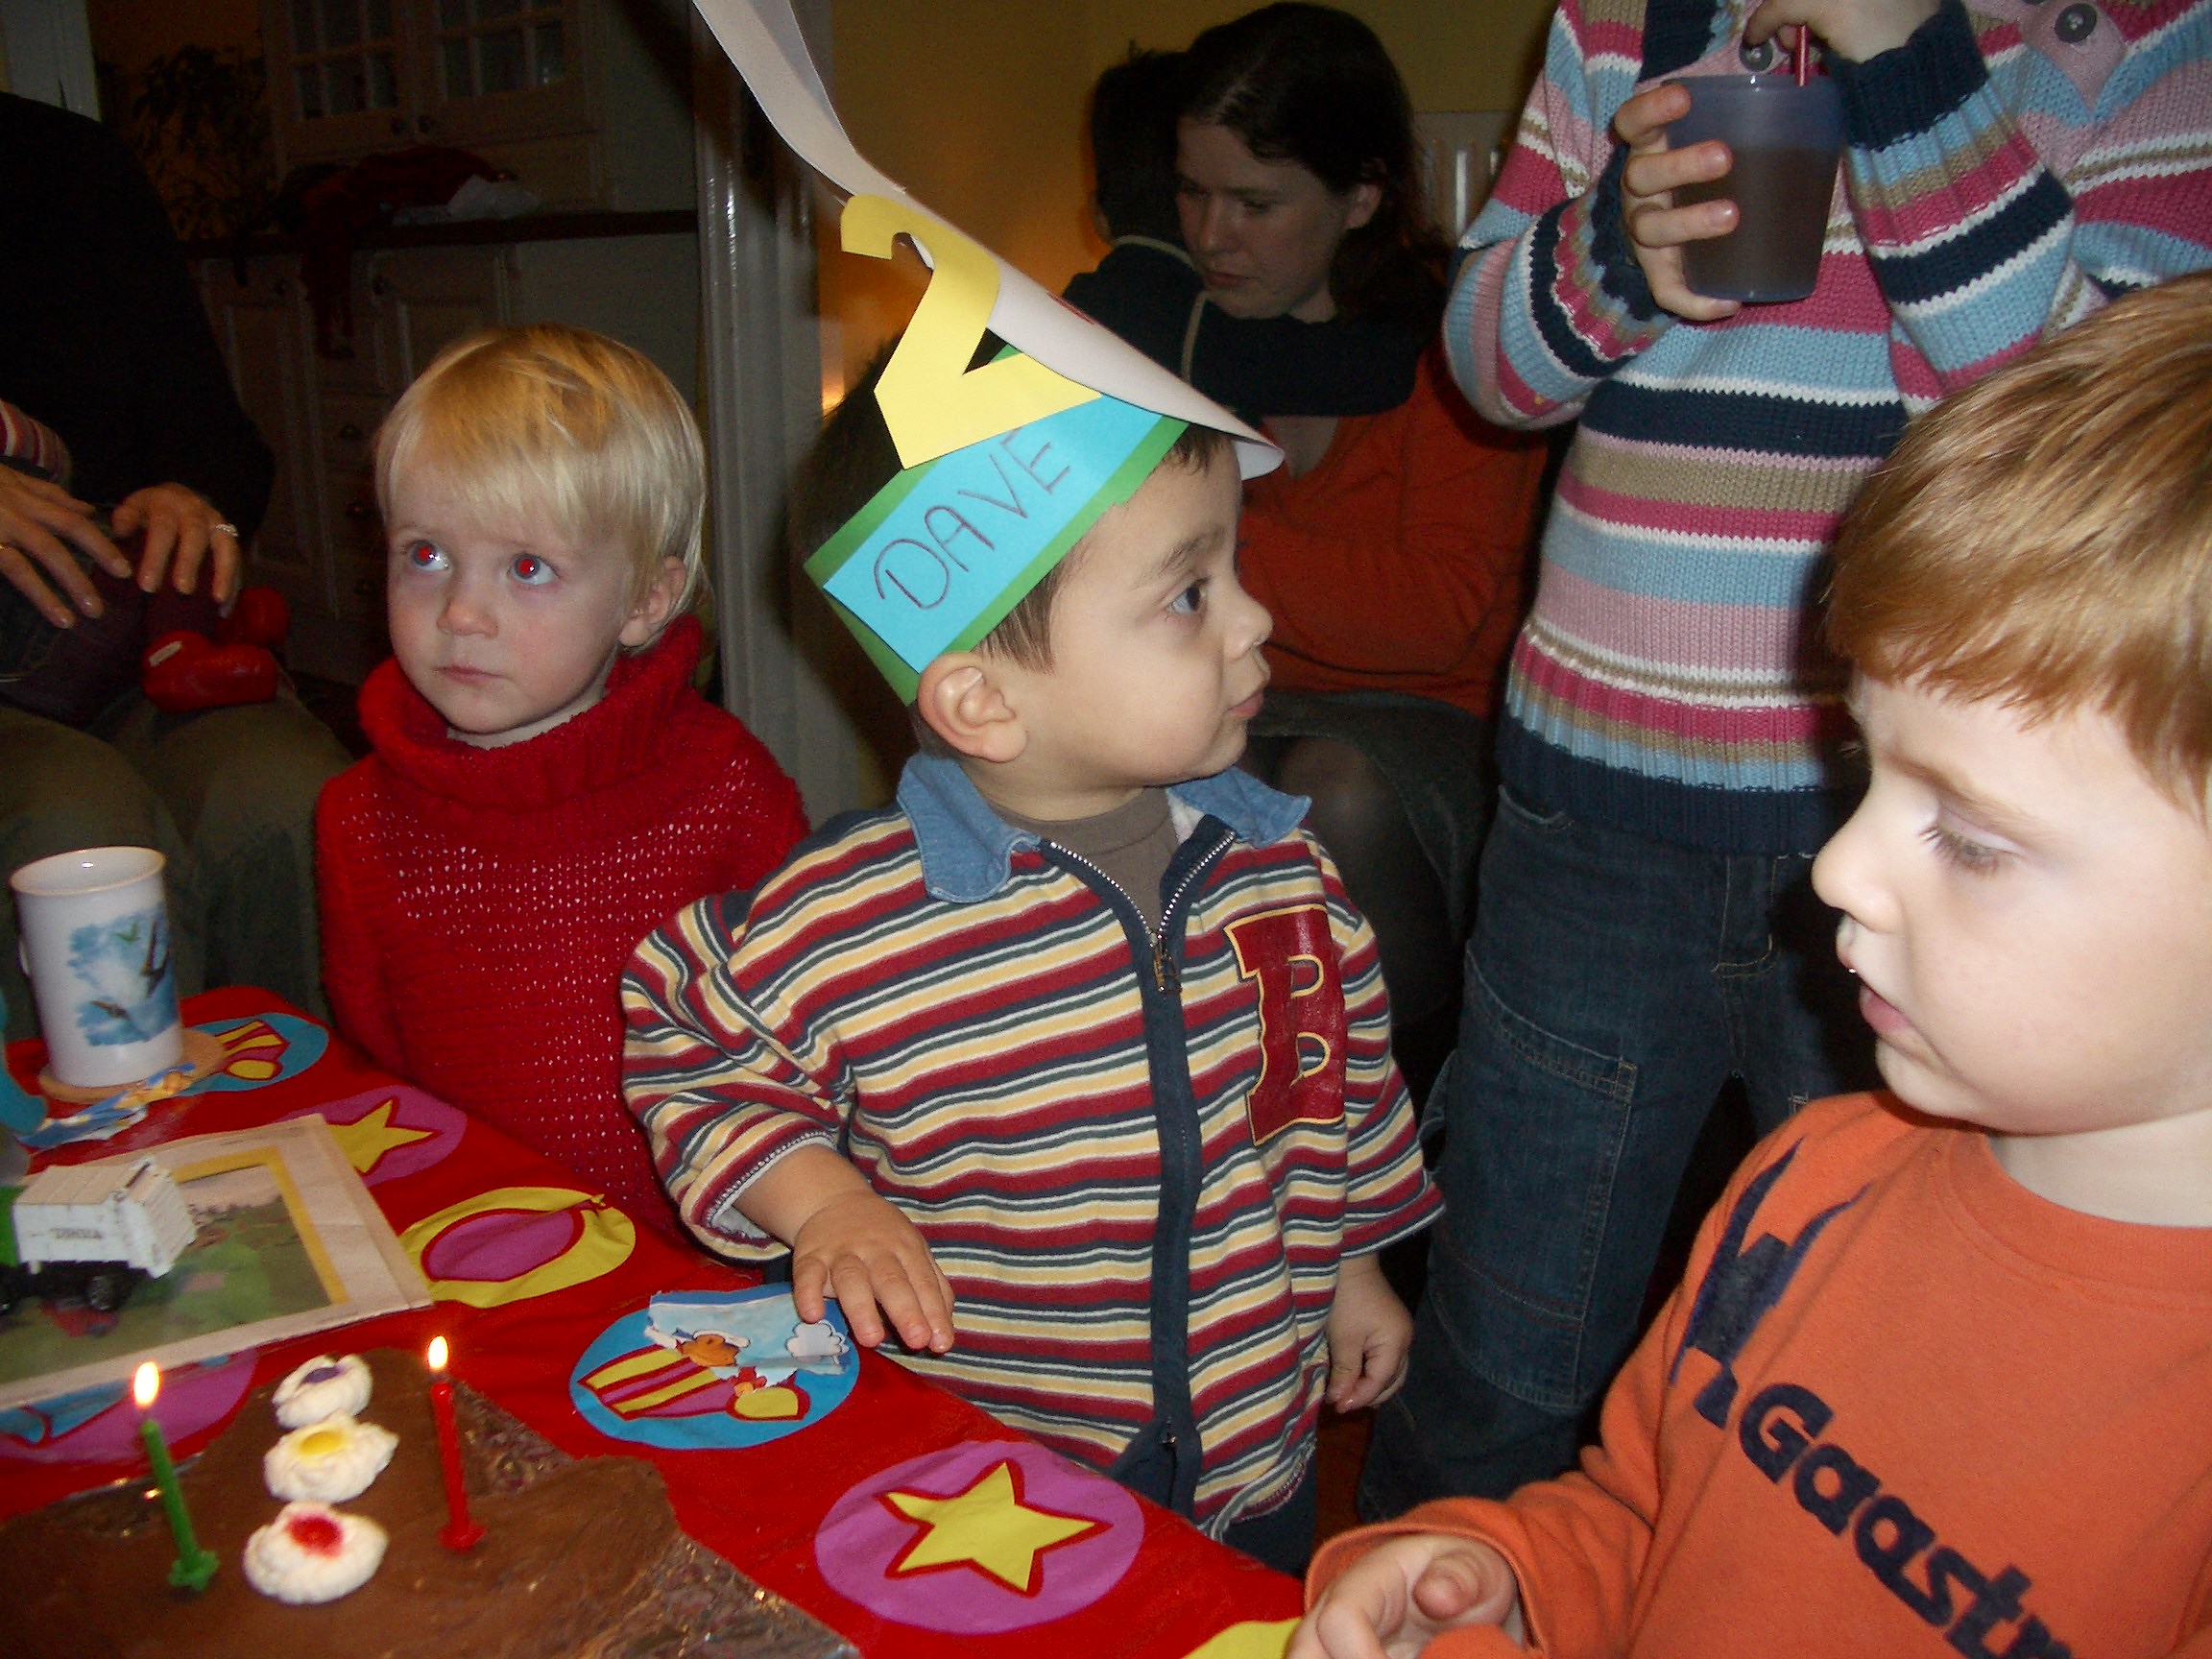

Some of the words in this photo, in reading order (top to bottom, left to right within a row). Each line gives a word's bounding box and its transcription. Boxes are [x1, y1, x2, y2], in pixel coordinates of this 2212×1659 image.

[840, 194, 1101, 469] 2
[874, 428, 1070, 610] DAVE
[1223, 902, 1346, 1147] B
